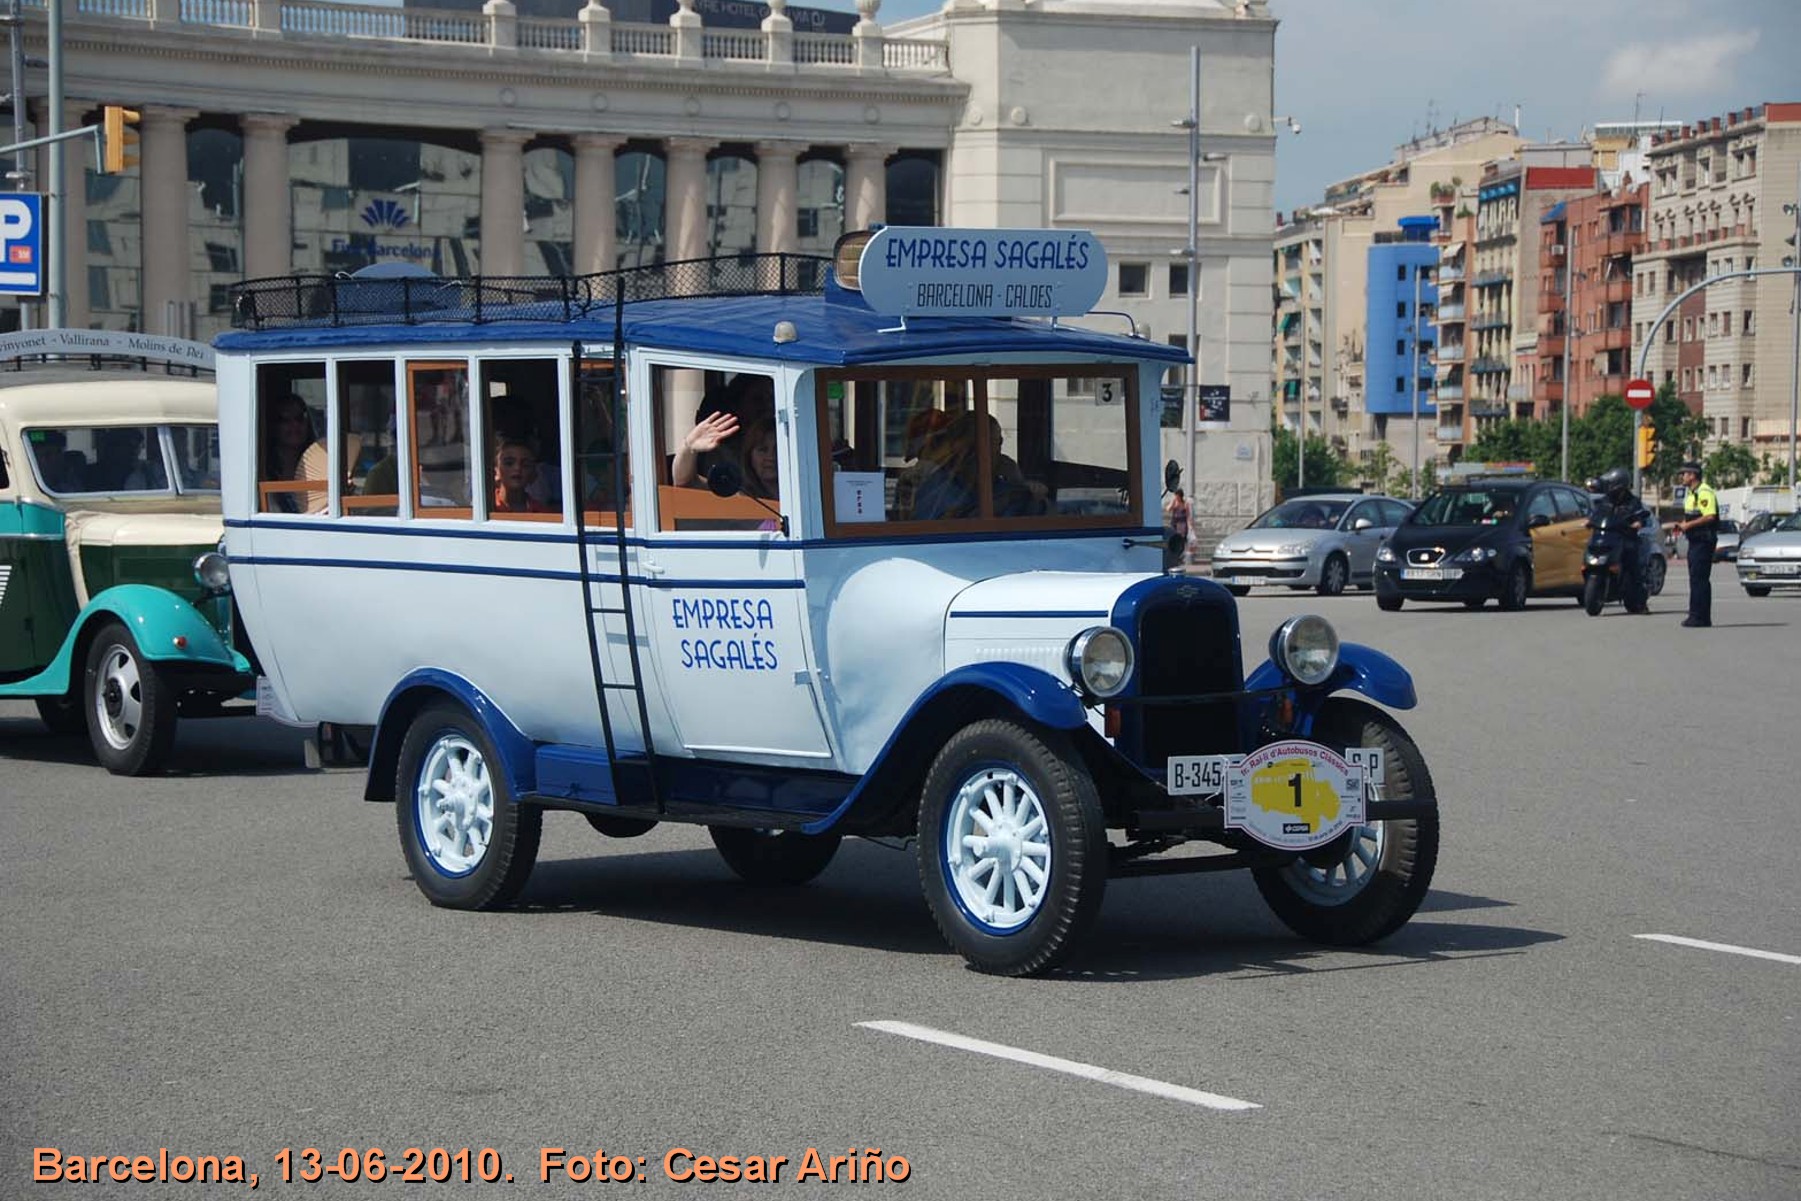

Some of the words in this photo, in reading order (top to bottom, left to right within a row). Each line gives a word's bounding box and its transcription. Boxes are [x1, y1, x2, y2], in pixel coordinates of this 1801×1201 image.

[886, 238, 986, 268] EMPRESA
[994, 234, 1089, 270] SAGALÉS
[917, 283, 994, 308] BARCELONA
[1005, 283, 1053, 309] CALDES
[59, 333, 110, 346] Vallirana
[128, 338, 166, 352] Molins
[168, 343, 182, 354] de
[1102, 383, 1113, 402] 3
[672, 598, 774, 629] EMPRESA
[681, 632, 778, 670] SAGALÉS
[1270, 746, 1318, 758] d'Autobusos
[1175, 761, 1241, 788] B-345
[1288, 773, 1302, 807] 1
